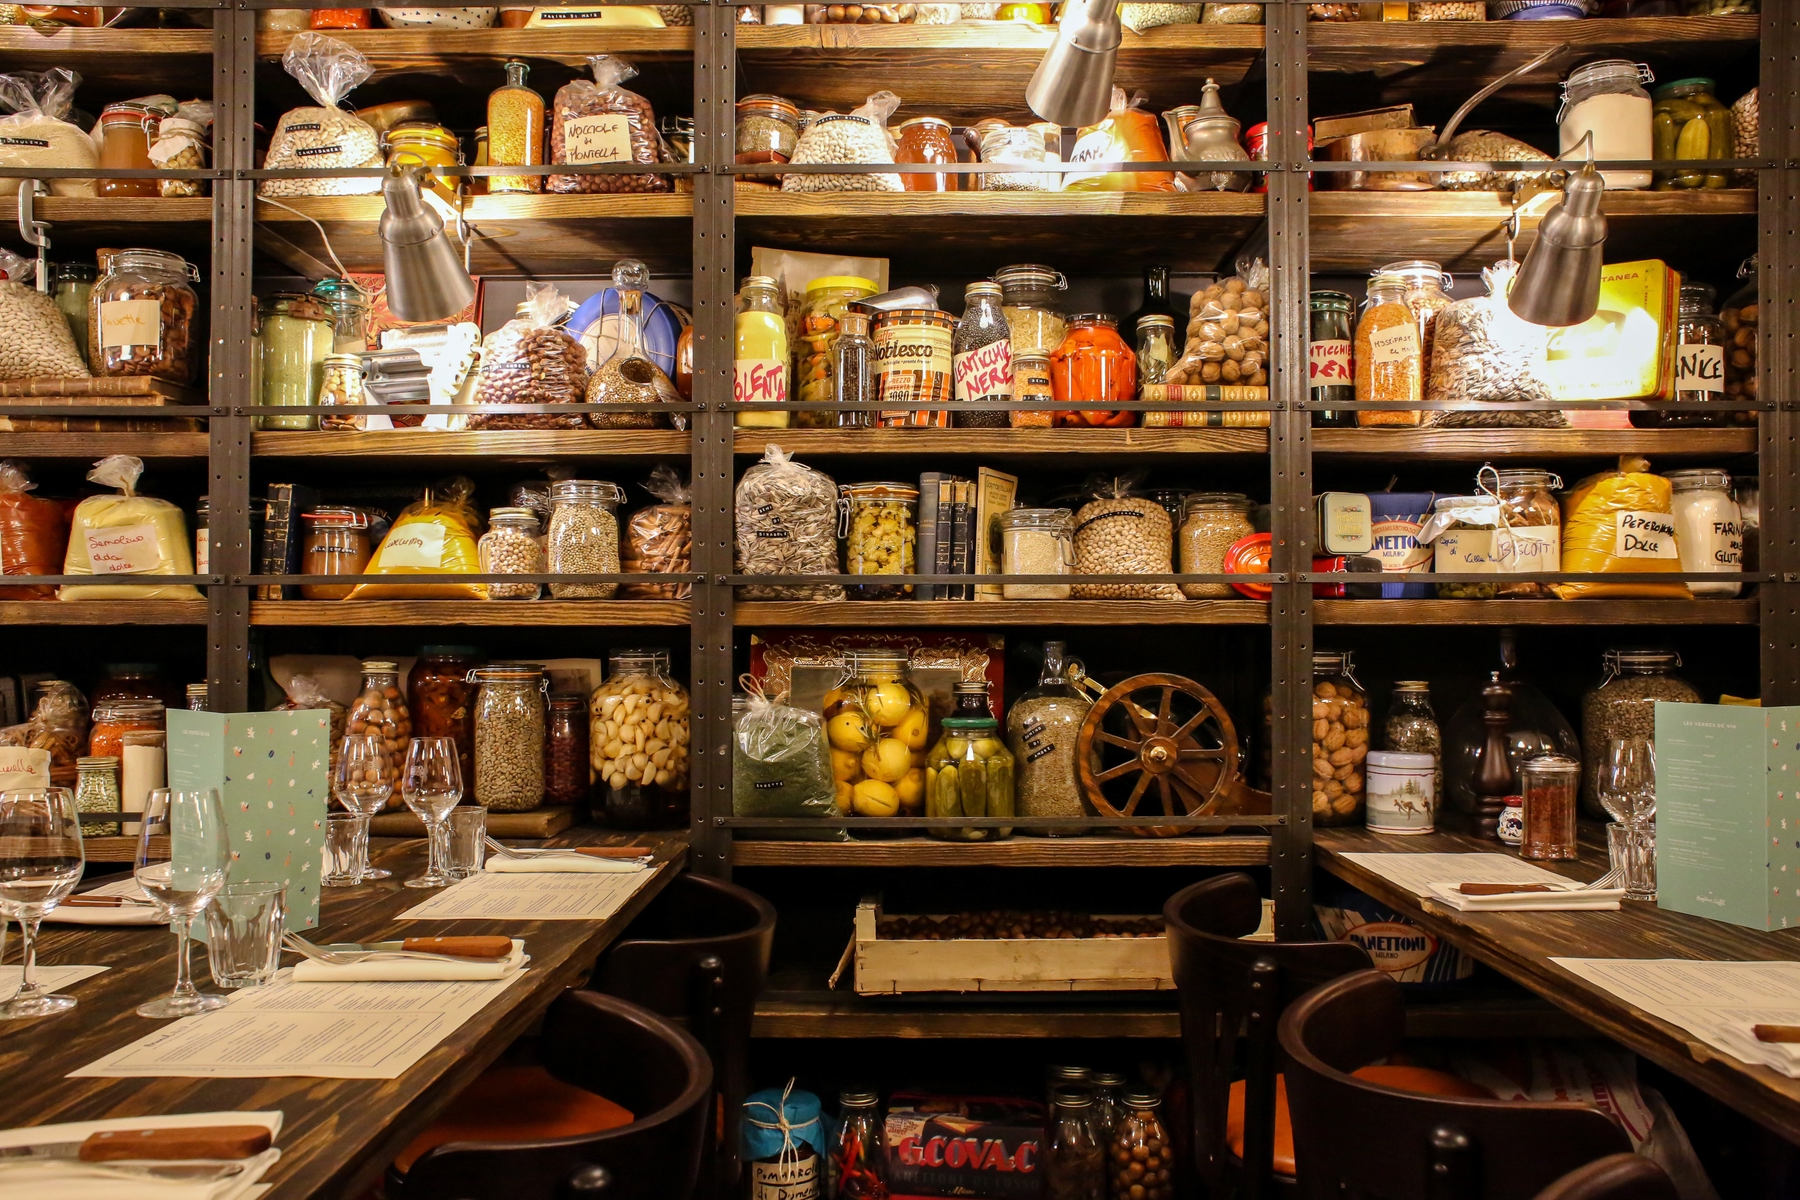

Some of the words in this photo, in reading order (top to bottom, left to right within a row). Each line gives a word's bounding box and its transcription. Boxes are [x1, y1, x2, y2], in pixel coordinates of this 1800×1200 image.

[568, 123, 619, 138] NOCCIOLE
[875, 340, 934, 361] Noblesco
[1676, 349, 1723, 380] NiCE
[1382, 550, 1406, 558] MILANO
[892, 1170, 965, 1185] ANETTONE
